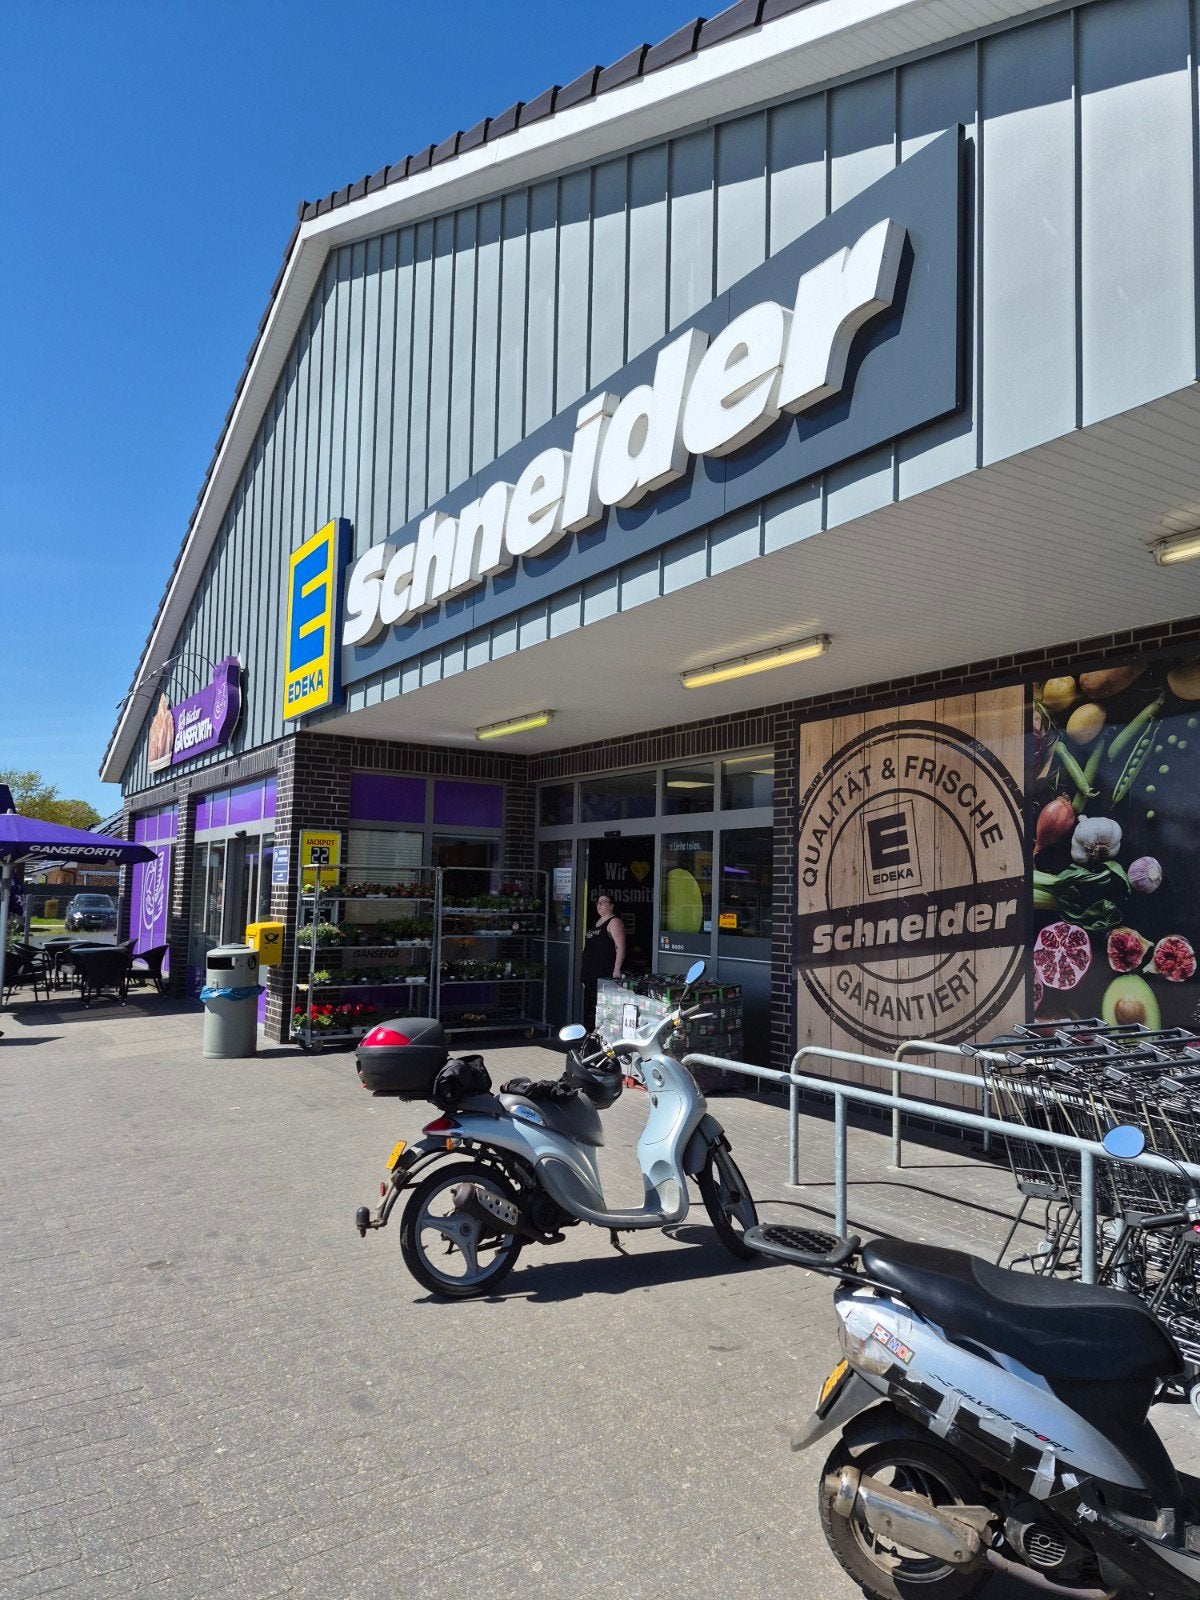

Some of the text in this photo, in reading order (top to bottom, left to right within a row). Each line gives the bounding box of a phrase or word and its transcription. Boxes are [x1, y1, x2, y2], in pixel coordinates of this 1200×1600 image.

[342, 218, 907, 645] Schneider
[288, 668, 324, 704] EDEKA
[802, 755, 1004, 887] QUALITÄT & FRISCHE
[29, 845, 123, 858] GANSEFORTH
[305, 839, 335, 847] JACKPOT
[311, 847, 329, 864] 22
[604, 862, 628, 881] Wir
[872, 867, 914, 885] EDEKA
[590, 884, 654, 903] ebensmit
[836, 958, 980, 1023] GARANTIERT
[953, 1388, 1074, 1453] SILVER SPORT
